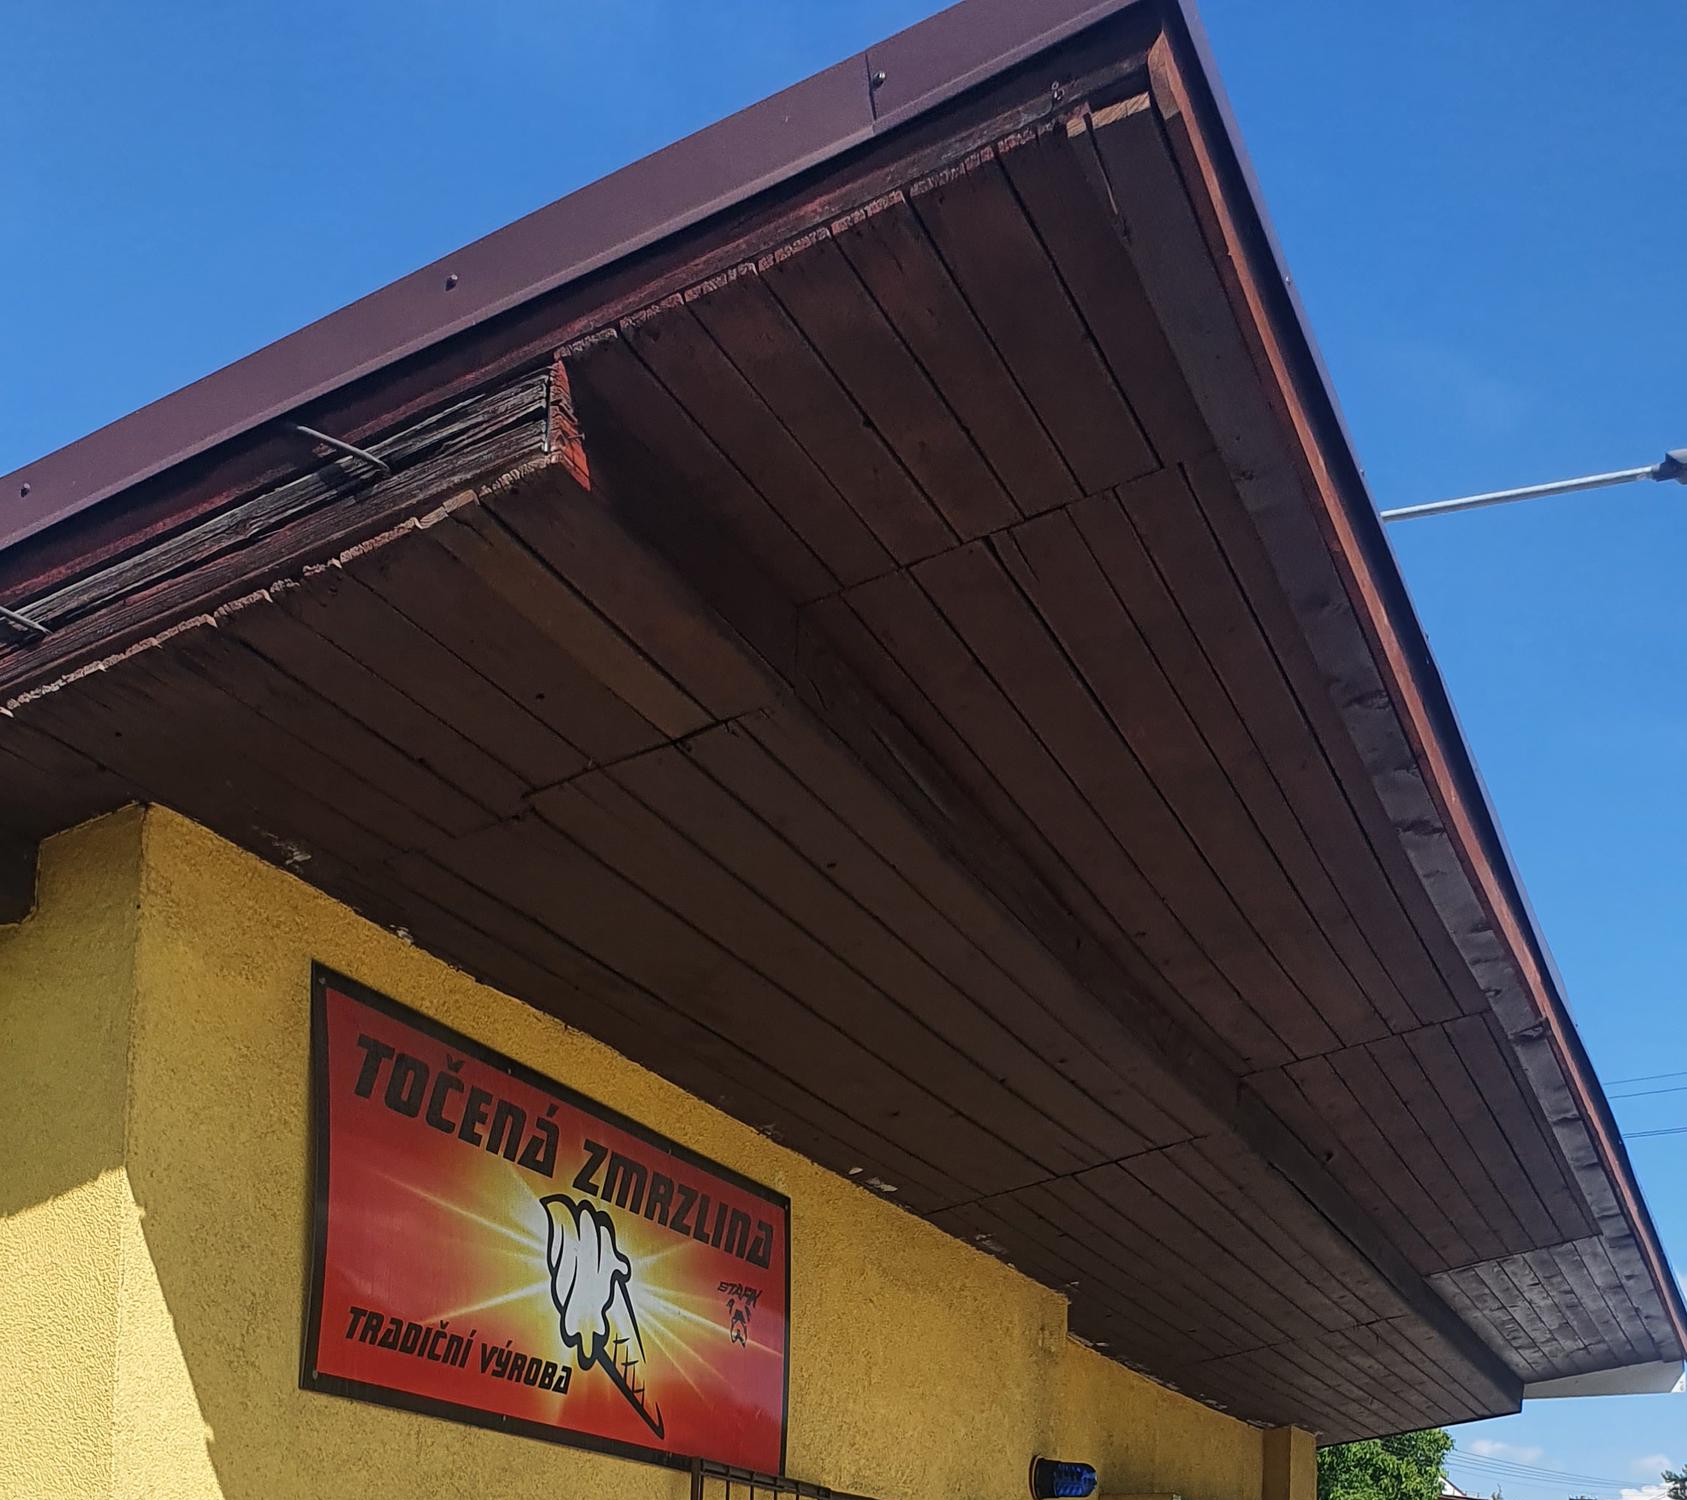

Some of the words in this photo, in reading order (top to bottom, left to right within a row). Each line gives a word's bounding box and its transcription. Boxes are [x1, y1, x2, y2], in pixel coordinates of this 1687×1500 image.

[354, 1033, 560, 1179] TOČENÁ
[572, 1138, 774, 1270] ZMRZLINA
[345, 1306, 477, 1369] TRADIČNÍ
[480, 1340, 573, 1395] VÝROBA
